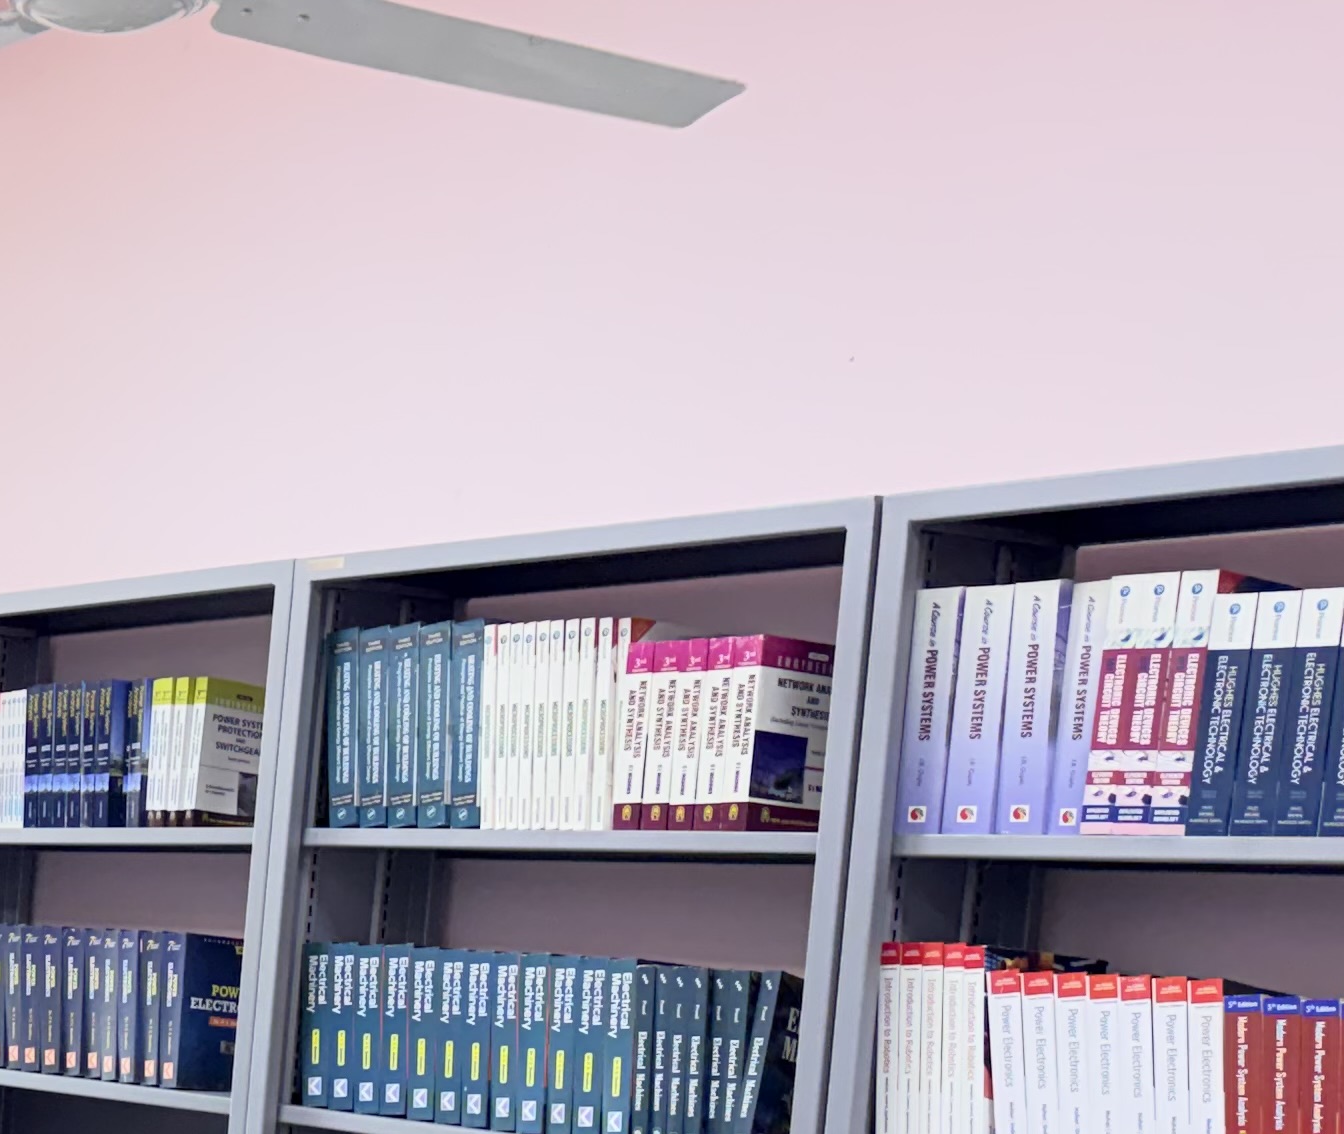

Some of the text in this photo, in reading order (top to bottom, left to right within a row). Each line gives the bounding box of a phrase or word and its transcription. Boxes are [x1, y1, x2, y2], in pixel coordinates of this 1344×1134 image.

[930, 610, 941, 637] Course
[777, 677, 814, 692] NETWORK
[924, 650, 938, 688] POWER
[969, 647, 990, 740] POWER SYSTEMS
[1021, 644, 1039, 738] POWER SYSTEMS
[1072, 645, 1092, 740] POWER SYSTEMS
[1211, 655, 1228, 714] ELECTRONIC
[1223, 666, 1238, 707] HUGHES
[1268, 664, 1283, 707] HUGHES
[213, 713, 240, 725] POWER
[624, 690, 637, 751] AND SYNTHESIS
[633, 680, 647, 759] NETWORK ANALYSIS
[732, 683, 745, 748] AND SYNTHESIS
[741, 674, 756, 755] NETWORK ANALYSIS
[807, 696, 819, 704] AND
[918, 691, 934, 740] SYSTEMS
[1248, 654, 1273, 784] ELECTRONIC TECHNOLOGY
[216, 741, 260, 757] SWITCHGEA
[1202, 715, 1221, 784] TECHNOLOGY
[1216, 709, 1232, 762] ELECTRICAL
[1260, 708, 1277, 763] ELECTRICAL
[190, 996, 238, 1013] ELECTR
[332, 955, 344, 1014] Machinery
[343, 954, 354, 1006] Electrical
[385, 958, 398, 1017] Machinery
[397, 957, 408, 1009] Electrical
[412, 961, 424, 1022] Machinery
[424, 960, 435, 1013] Electrical
[607, 973, 622, 1039] Machinery
[620, 972, 632, 1030] Electrical
[884, 978, 893, 1027] Introduction
[1001, 1005, 1013, 1087] Power Electronics
[1034, 1006, 1047, 1089] Power Electronics
[1068, 1009, 1080, 1092] Power Electronics
[1165, 1014, 1177, 1101] Power Electronics
[1237, 1016, 1248, 1044] Modern
[1237, 1044, 1248, 1068] Power
[634, 1031, 647, 1111] Electrical Machines
[724, 1039, 739, 1122] Electrical Machines
[1236, 1068, 1248, 1095] System
[1236, 1096, 1248, 1127] Analysis
